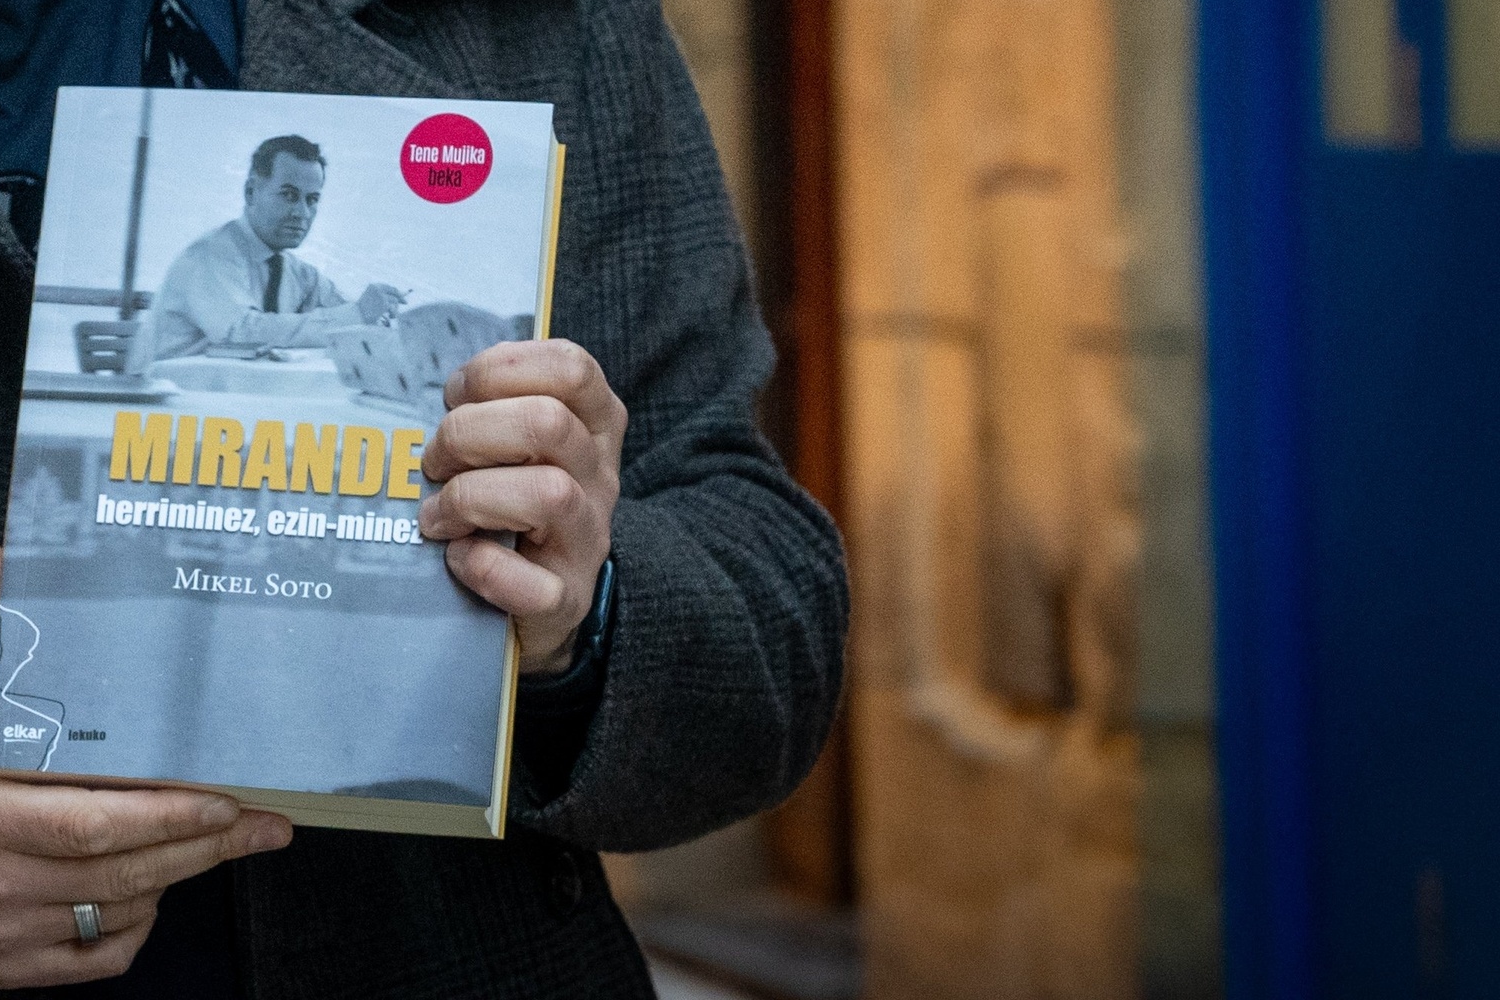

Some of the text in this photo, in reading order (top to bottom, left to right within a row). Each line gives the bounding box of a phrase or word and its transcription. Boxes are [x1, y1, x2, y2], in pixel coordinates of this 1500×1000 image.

[409, 143, 485, 165] Tene Mujika
[429, 168, 461, 187] beka
[110, 411, 424, 499] MIRANDE
[96, 494, 260, 536] herriminez,
[3, 725, 46, 739] elkar
